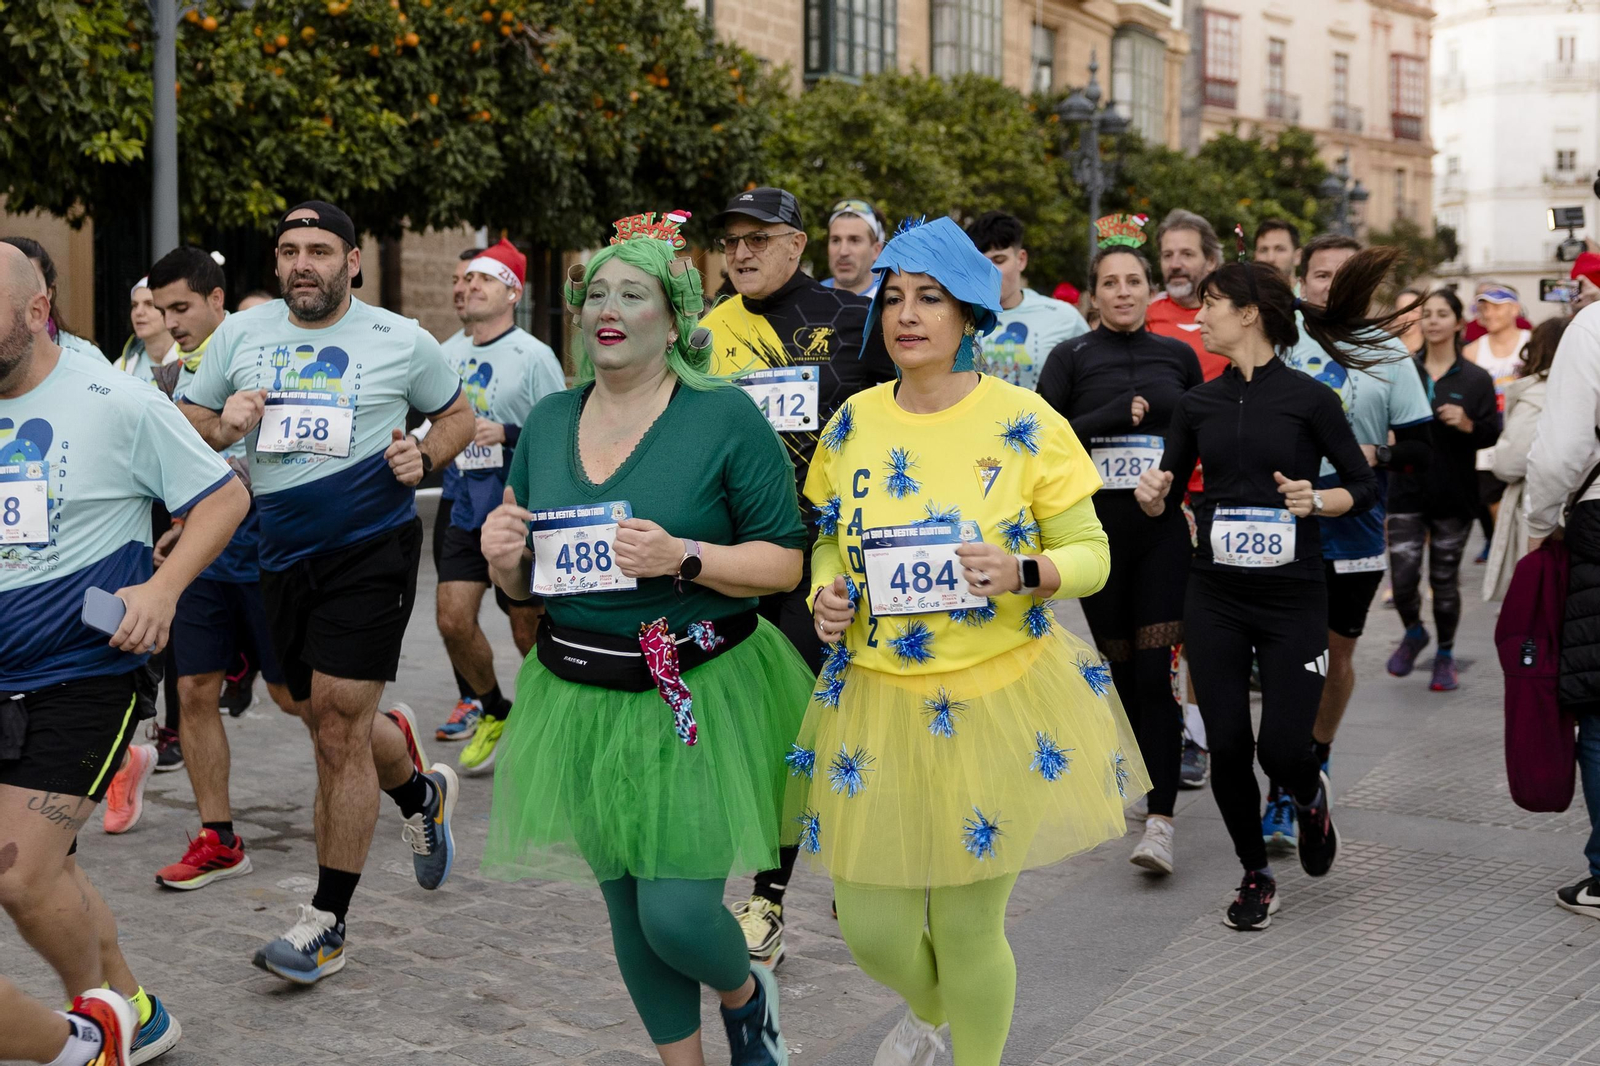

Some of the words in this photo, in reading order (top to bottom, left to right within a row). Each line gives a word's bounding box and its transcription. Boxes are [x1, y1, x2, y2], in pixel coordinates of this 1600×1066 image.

[280, 416, 329, 441] 158
[1101, 457, 1154, 477] 1287
[50, 441, 69, 547] GADITANA
[3, 496, 21, 526] 8
[548, 510, 576, 520] SILVESTRE
[883, 526, 919, 538] SILVESTRE
[920, 525, 951, 536] GADITANA
[1221, 532, 1282, 555] 1288
[556, 540, 612, 575] 488
[890, 560, 958, 595] 484
